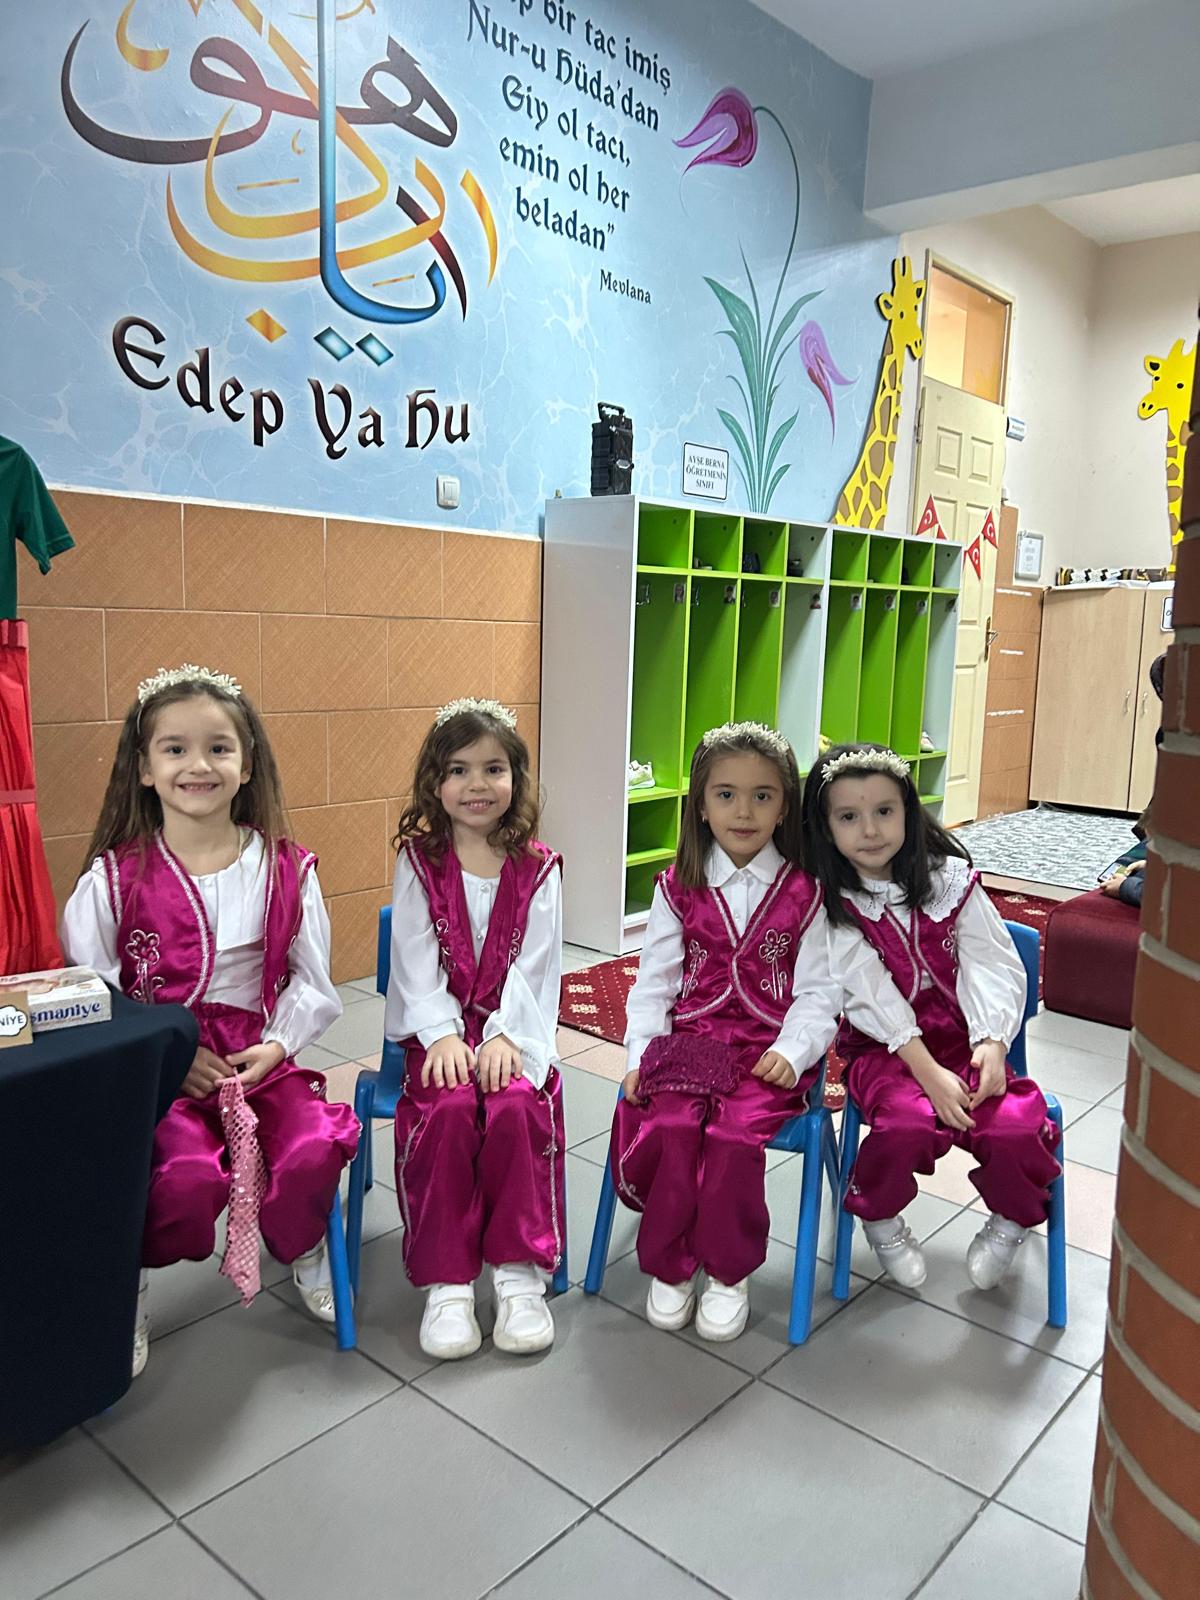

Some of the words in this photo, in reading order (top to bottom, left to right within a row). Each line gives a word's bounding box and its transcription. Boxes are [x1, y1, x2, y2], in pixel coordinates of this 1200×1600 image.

[467, 0, 546, 73] Nur-u
[543, 0, 576, 35] bir
[585, 18, 617, 58] tac
[625, 37, 671, 96] imiş
[502, 75, 548, 131] Giy
[558, 108, 578, 140] ol
[587, 121, 631, 168] tacı,
[500, 136, 559, 183] emin
[568, 163, 588, 196] ol
[597, 170, 630, 213] her
[600, 268, 652, 305] Mevlana
[112, 316, 284, 448] Edep
[308, 378, 385, 460] Ya
[405, 389, 471, 450] Hu
